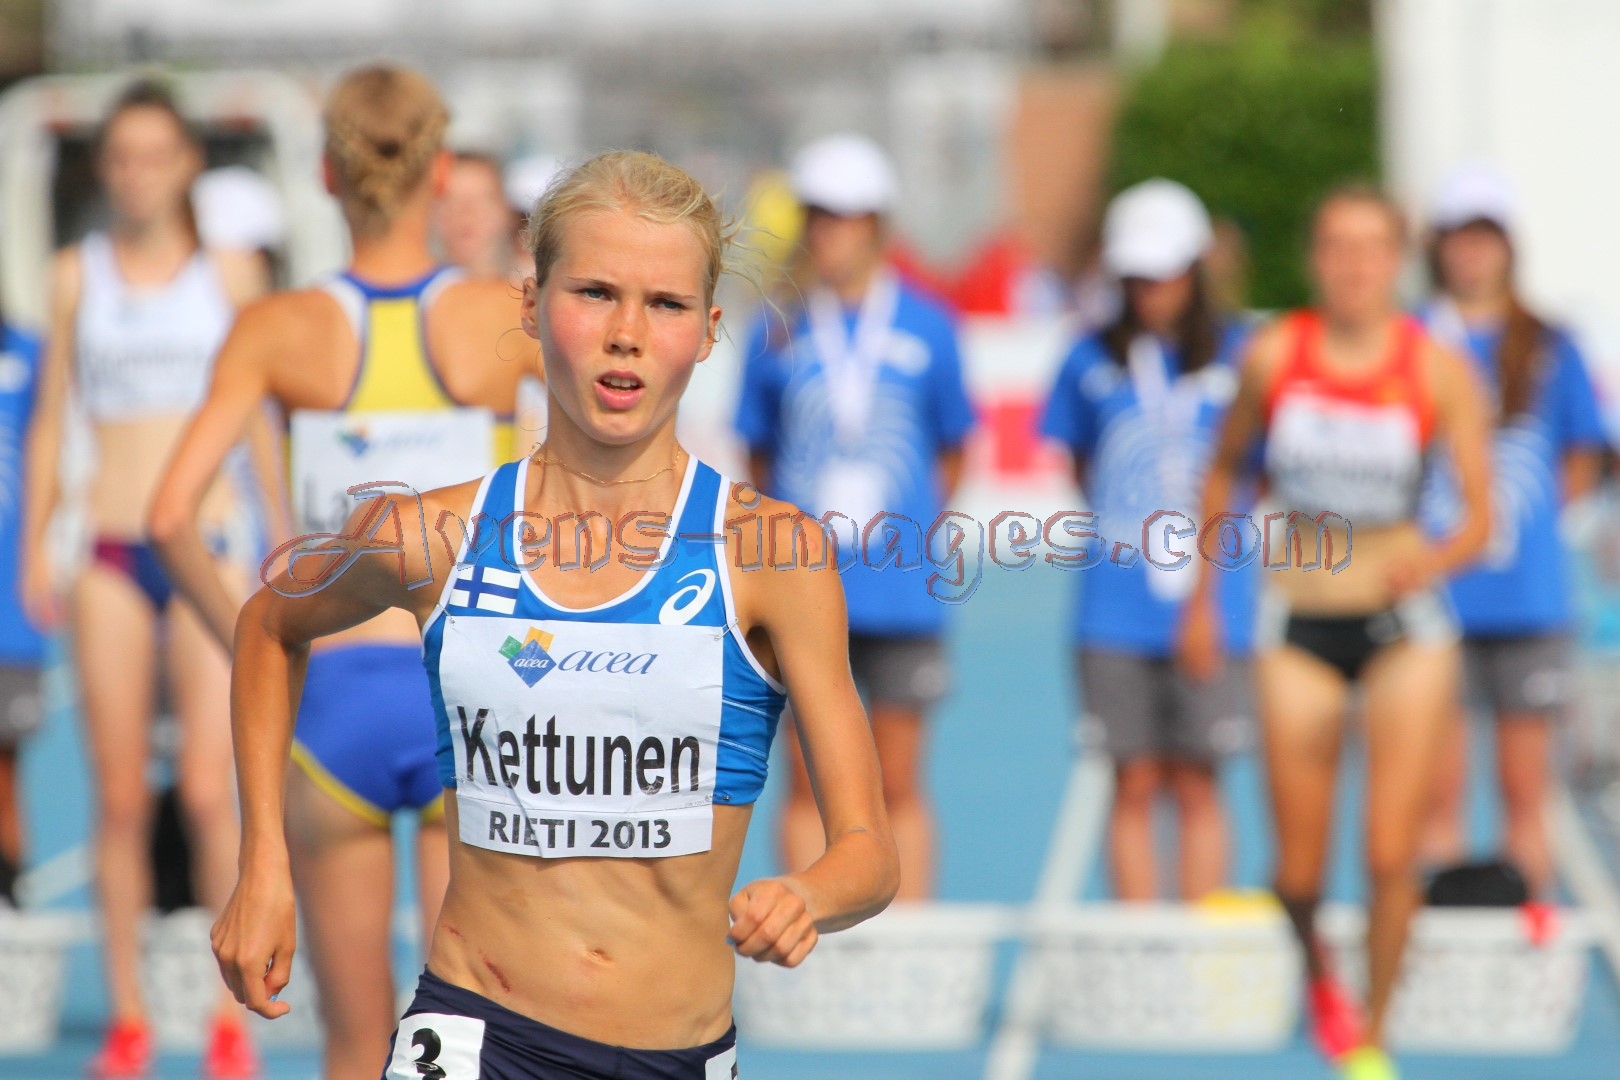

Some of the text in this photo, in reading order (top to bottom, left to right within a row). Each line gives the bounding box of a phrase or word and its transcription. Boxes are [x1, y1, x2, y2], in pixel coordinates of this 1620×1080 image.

[513, 657, 550, 669] acea
[557, 649, 659, 675] acea
[456, 705, 700, 797] Kettunen
[488, 810, 672, 850] RIETI 2013
